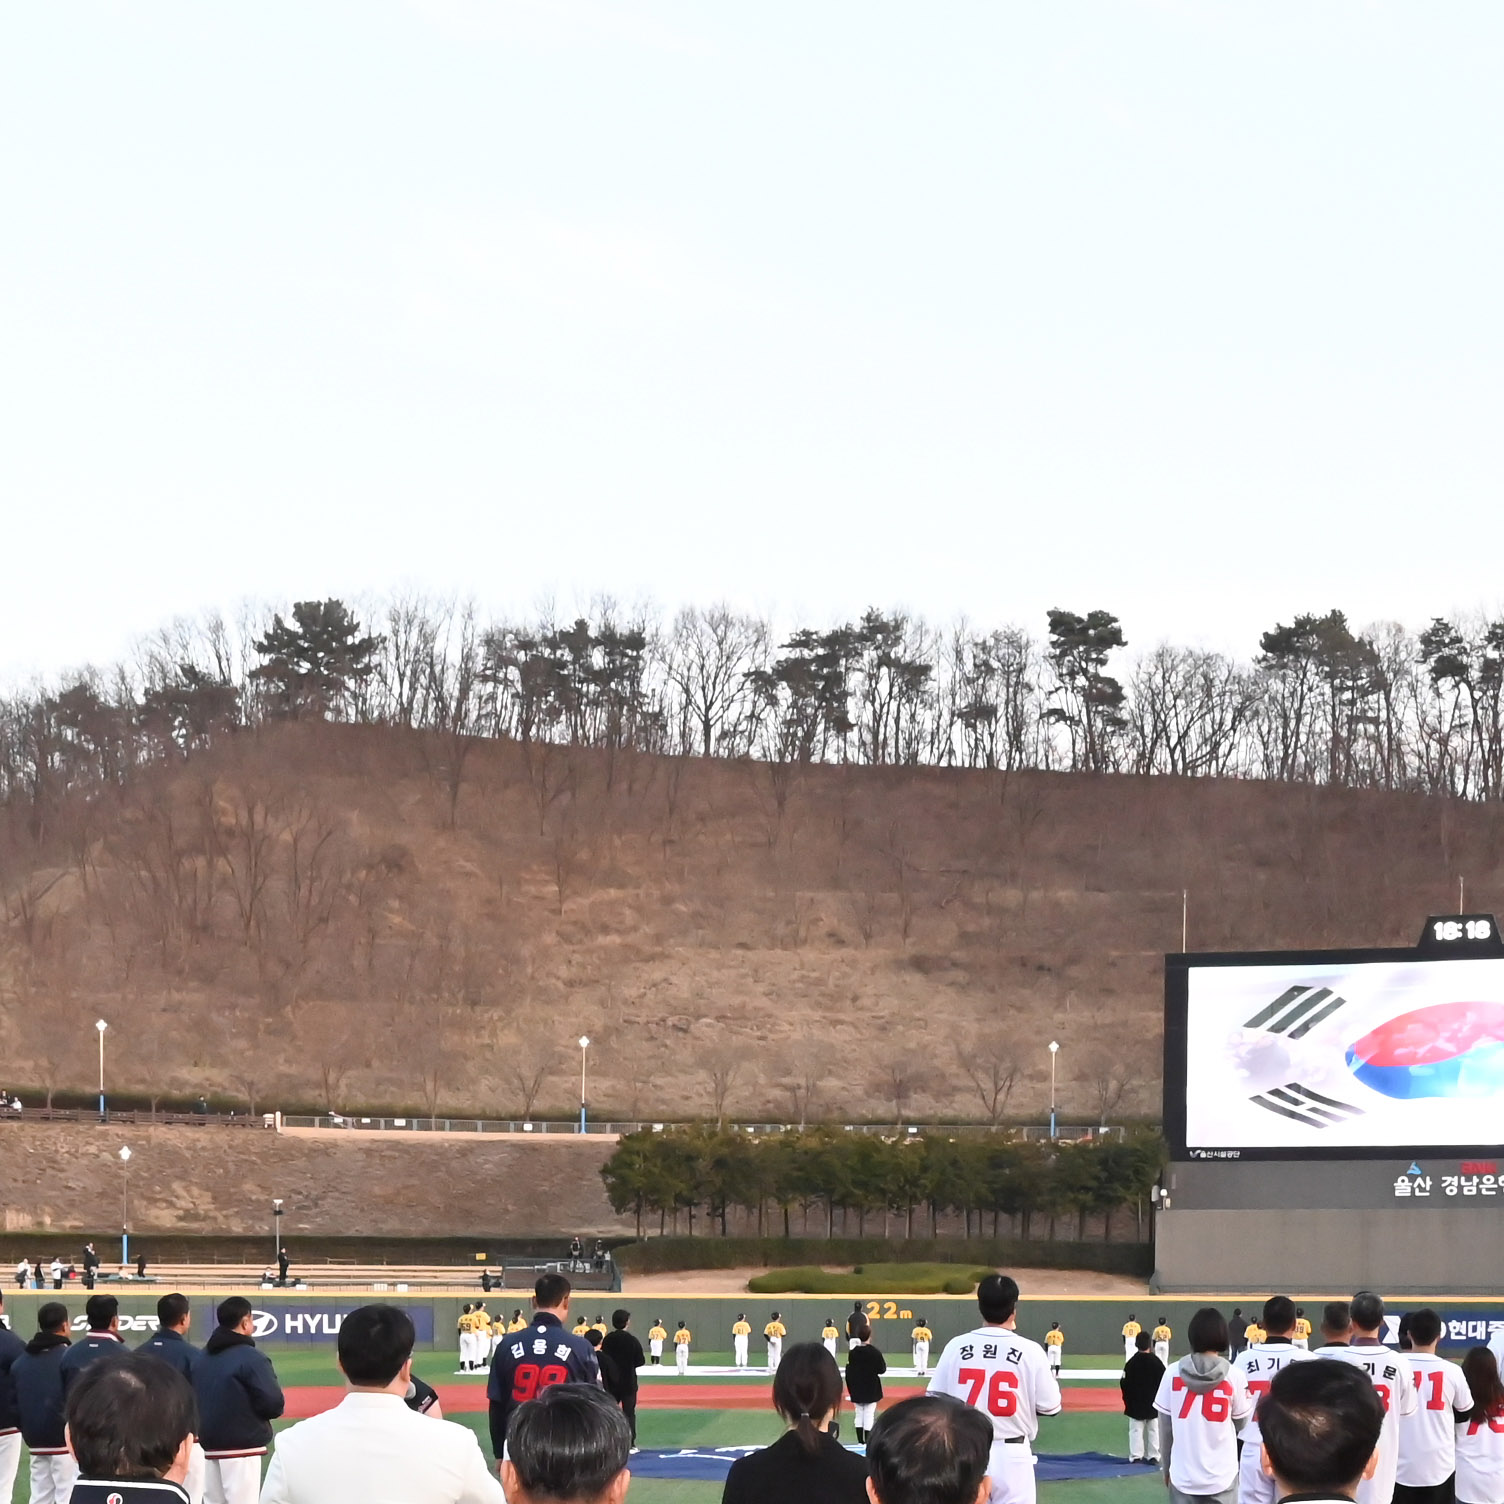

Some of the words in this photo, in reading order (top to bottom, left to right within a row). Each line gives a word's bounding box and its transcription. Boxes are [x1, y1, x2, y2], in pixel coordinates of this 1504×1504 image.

[1393, 1176, 1432, 1196] 울산
[70, 1315, 160, 1331] SDER
[285, 1314, 346, 1334] HYU
[959, 1344, 1023, 1365] 장원진
[1247, 1357, 1297, 1374] 최기
[958, 1368, 1018, 1416] 76
[1172, 1377, 1233, 1422] 76
